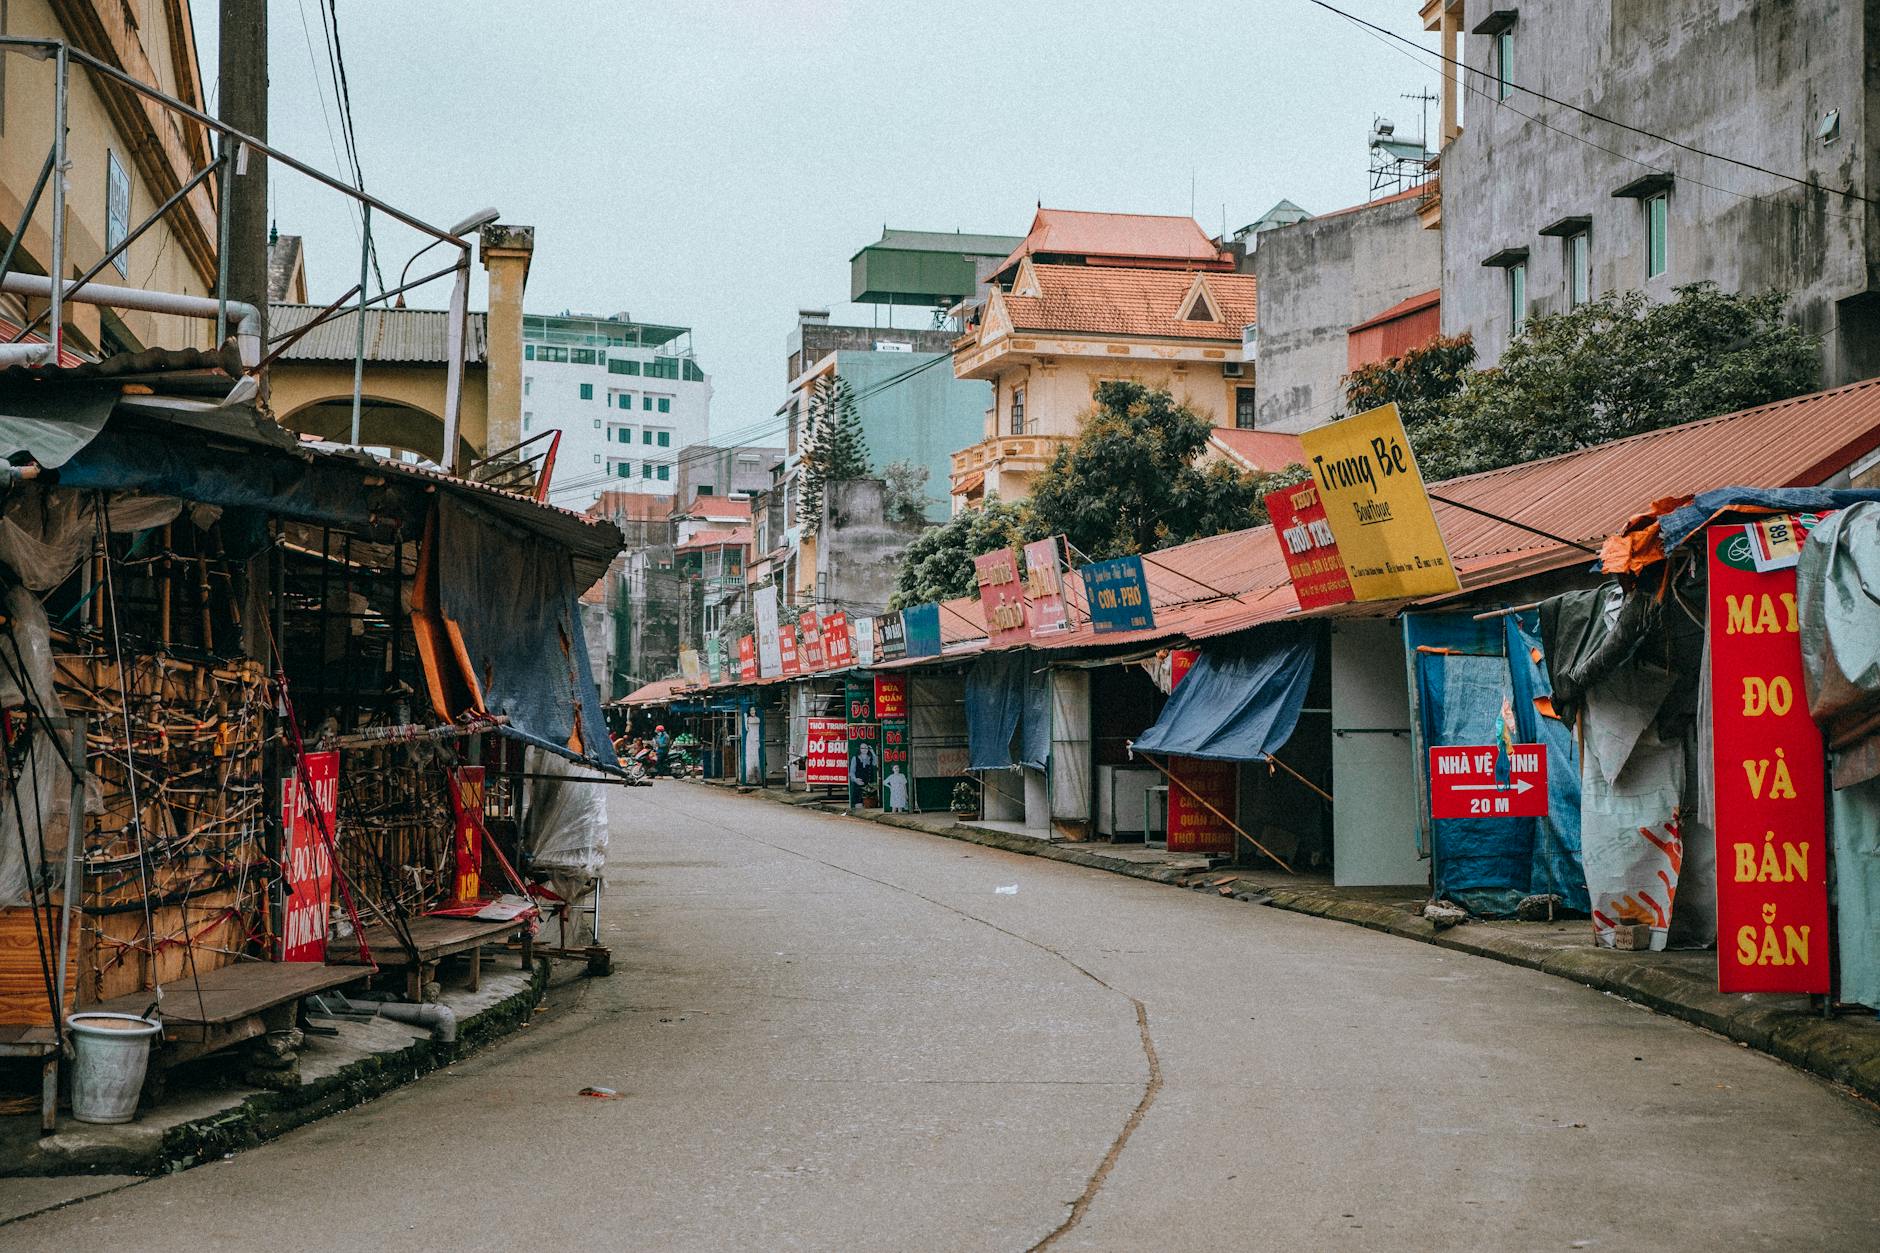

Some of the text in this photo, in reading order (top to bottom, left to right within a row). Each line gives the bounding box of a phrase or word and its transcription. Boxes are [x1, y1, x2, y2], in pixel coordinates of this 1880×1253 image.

[1313, 436, 1407, 494] Trang Bé
[1353, 499, 1392, 521] Boutique
[1725, 593, 1800, 635] MAY
[1742, 675, 1793, 717] ĐO
[1438, 752, 1539, 776] NHÀ VỆ INH
[1743, 747, 1797, 799] VÀ
[1470, 798, 1510, 813] 20 M
[1733, 831, 1809, 882] BÁN
